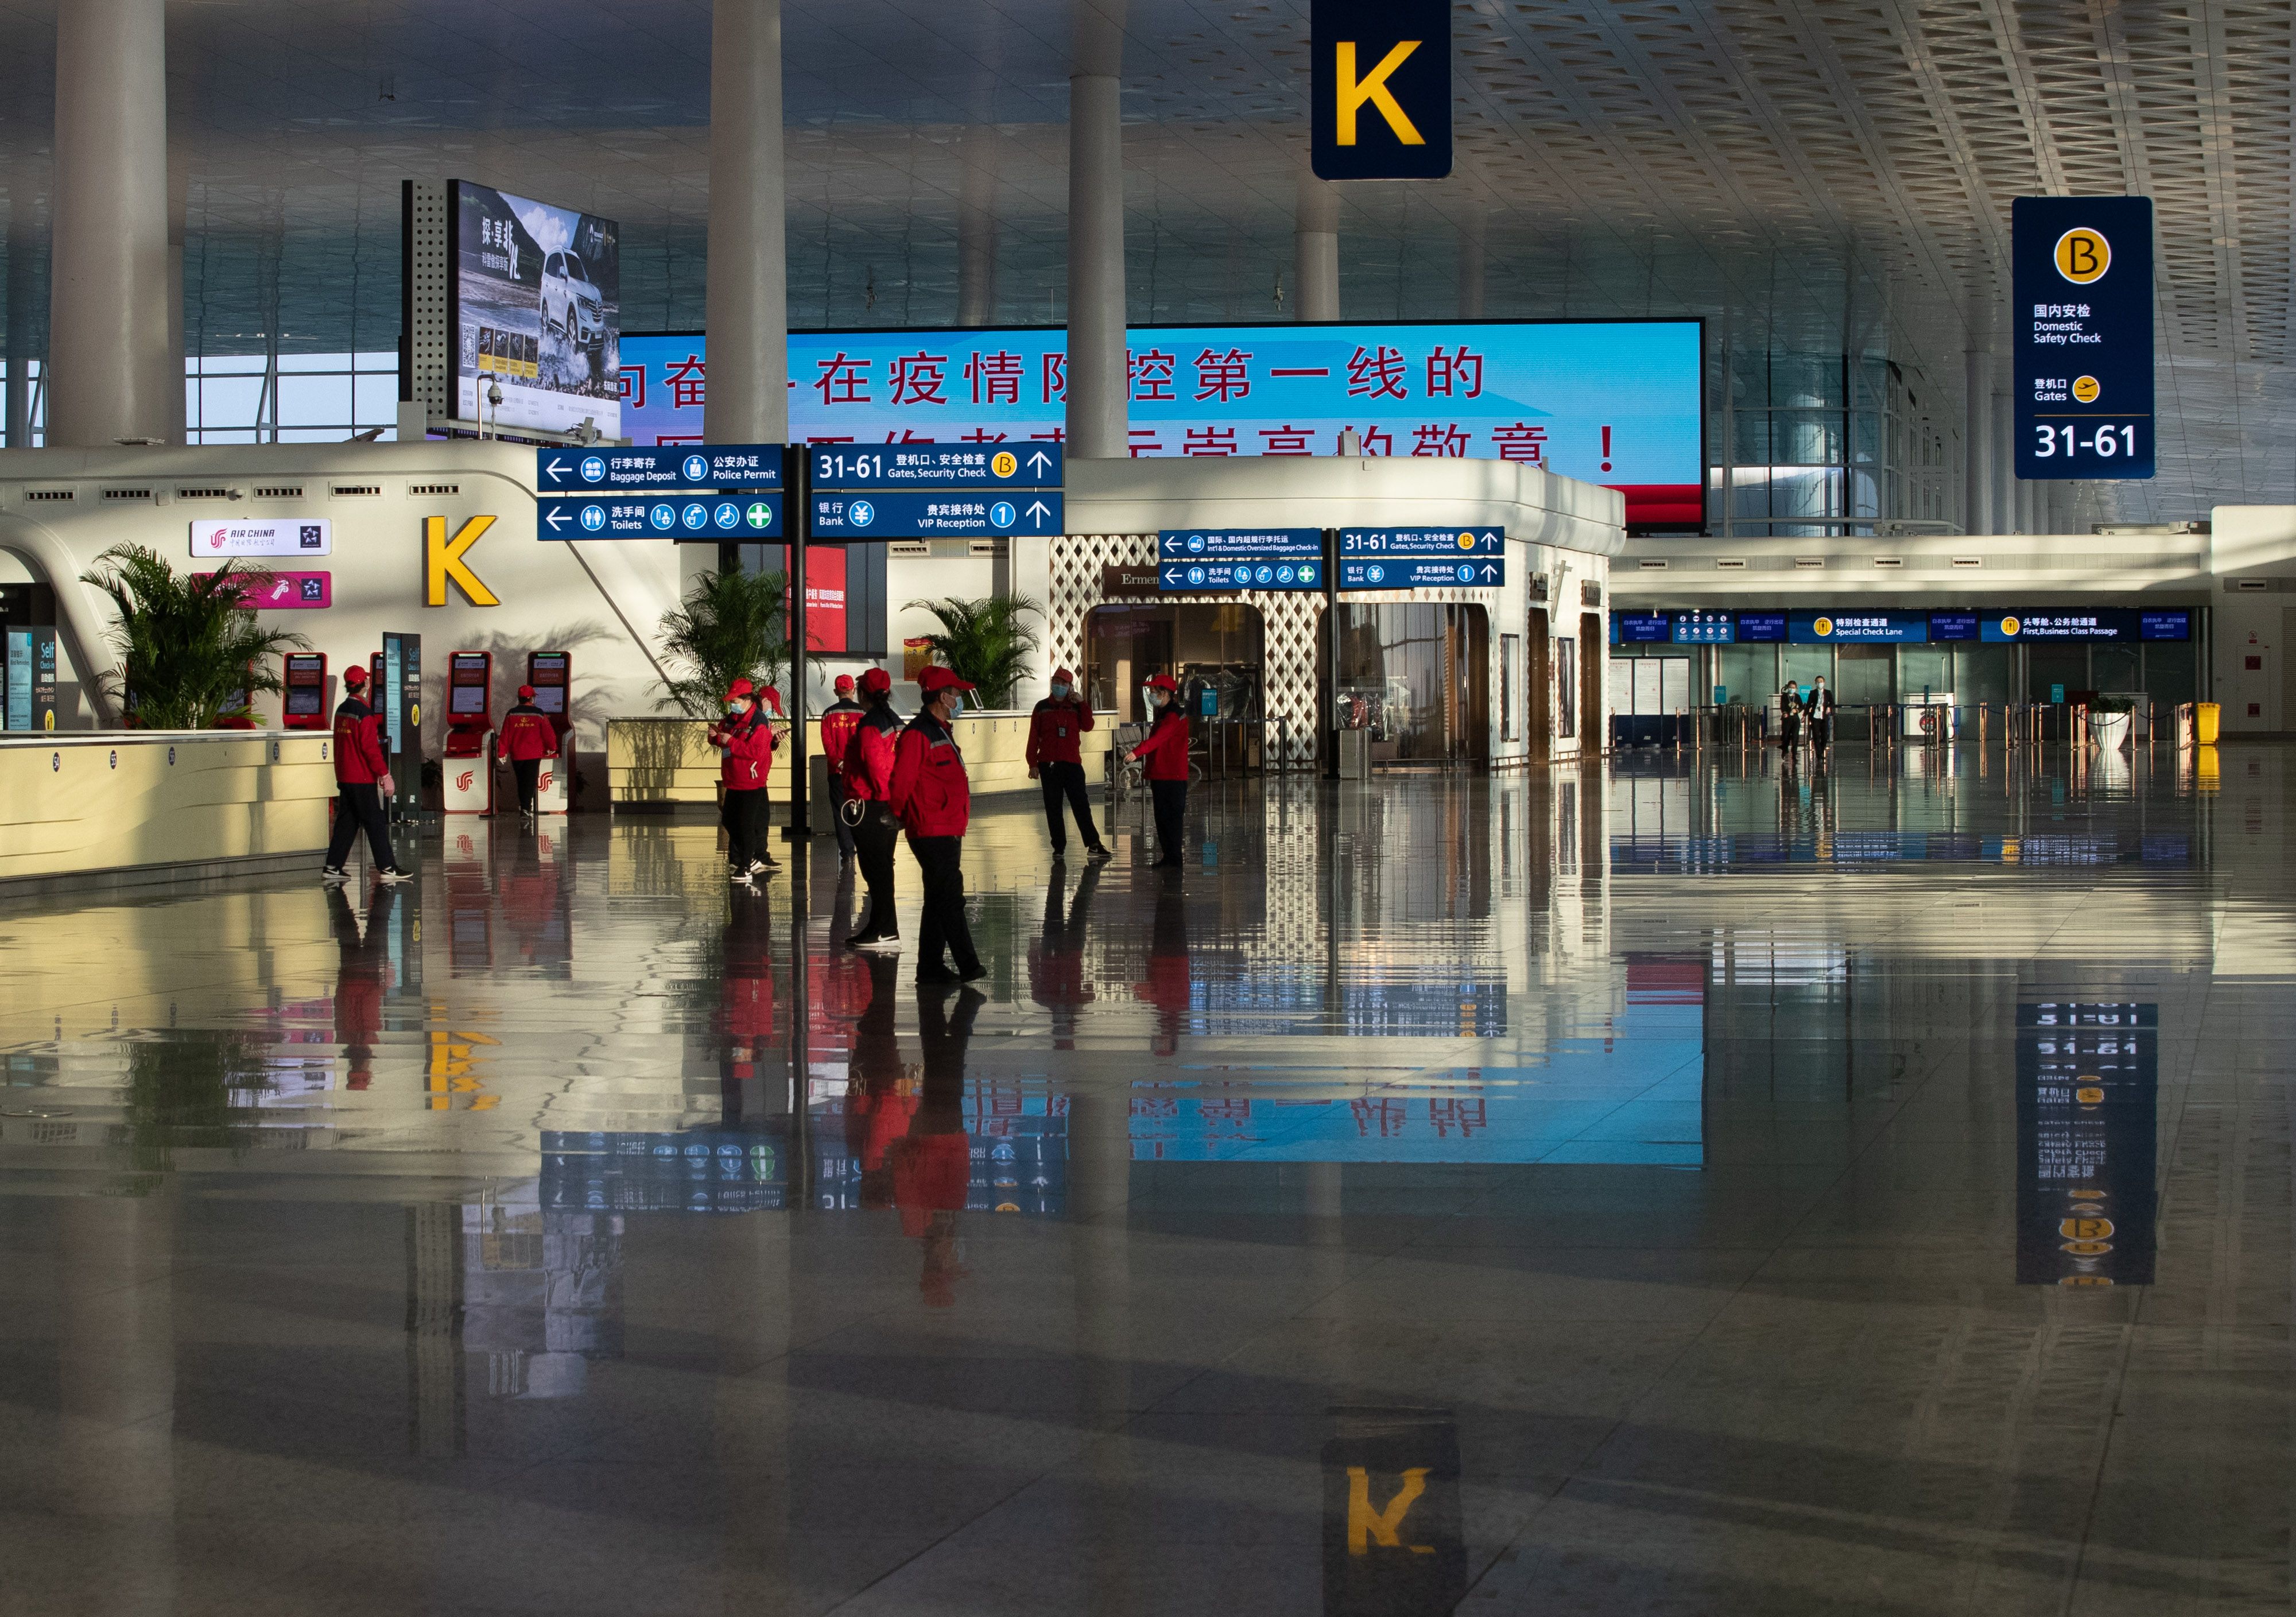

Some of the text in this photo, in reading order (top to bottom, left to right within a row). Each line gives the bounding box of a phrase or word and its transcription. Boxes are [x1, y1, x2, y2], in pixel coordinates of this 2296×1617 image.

[1336, 41, 1426, 146] K
[2070, 237, 2098, 274] B
[2034, 304, 2091, 318] 国内安检
[2034, 321, 2083, 331] Domestic
[2034, 332, 2101, 345] Safety Check
[2035, 379, 2067, 389] 登机口
[2035, 391, 2067, 401] Gates
[2035, 425, 2134, 457] 31-61
[610, 456, 759, 470] 行李寄存 公安办证
[896, 454, 986, 466] 登机口、安全检查
[999, 457, 1011, 472] B
[819, 455, 881, 478] 31-61
[610, 471, 676, 483] Baggage Deposit
[713, 470, 776, 480] Police Permit
[958, 467, 986, 478] Check
[611, 506, 645, 518] 洗手间
[819, 502, 843, 514] 银行
[927, 503, 985, 516] 贵宾接待处
[998, 506, 1006, 523] 1
[611, 520, 642, 529] Toilets
[819, 517, 844, 526] Bank
[918, 518, 986, 529] VIP Reception
[231, 529, 275, 538] AIR CHINA
[1395, 534, 1455, 542] 登机口、安全检查
[1207, 535, 1289, 544] 国际、国内超规行李托运
[1345, 534, 1386, 550] 31-61
[1463, 536, 1471, 546] B
[427, 515, 501, 606] K
[1208, 568, 1231, 576] 洗手间
[1347, 567, 1364, 575] 银行
[1416, 566, 1455, 574] 贵宾接待处
[1463, 568, 1468, 579] 1
[1836, 618, 1888, 627] 特别检查通道
[2023, 617, 2097, 627] 头等舱、公务舱通道
[1836, 628, 1861, 637] Special
[2090, 628, 2117, 636] Passage
[41, 641, 55, 659] Self
[40, 661, 55, 669] Check-in
